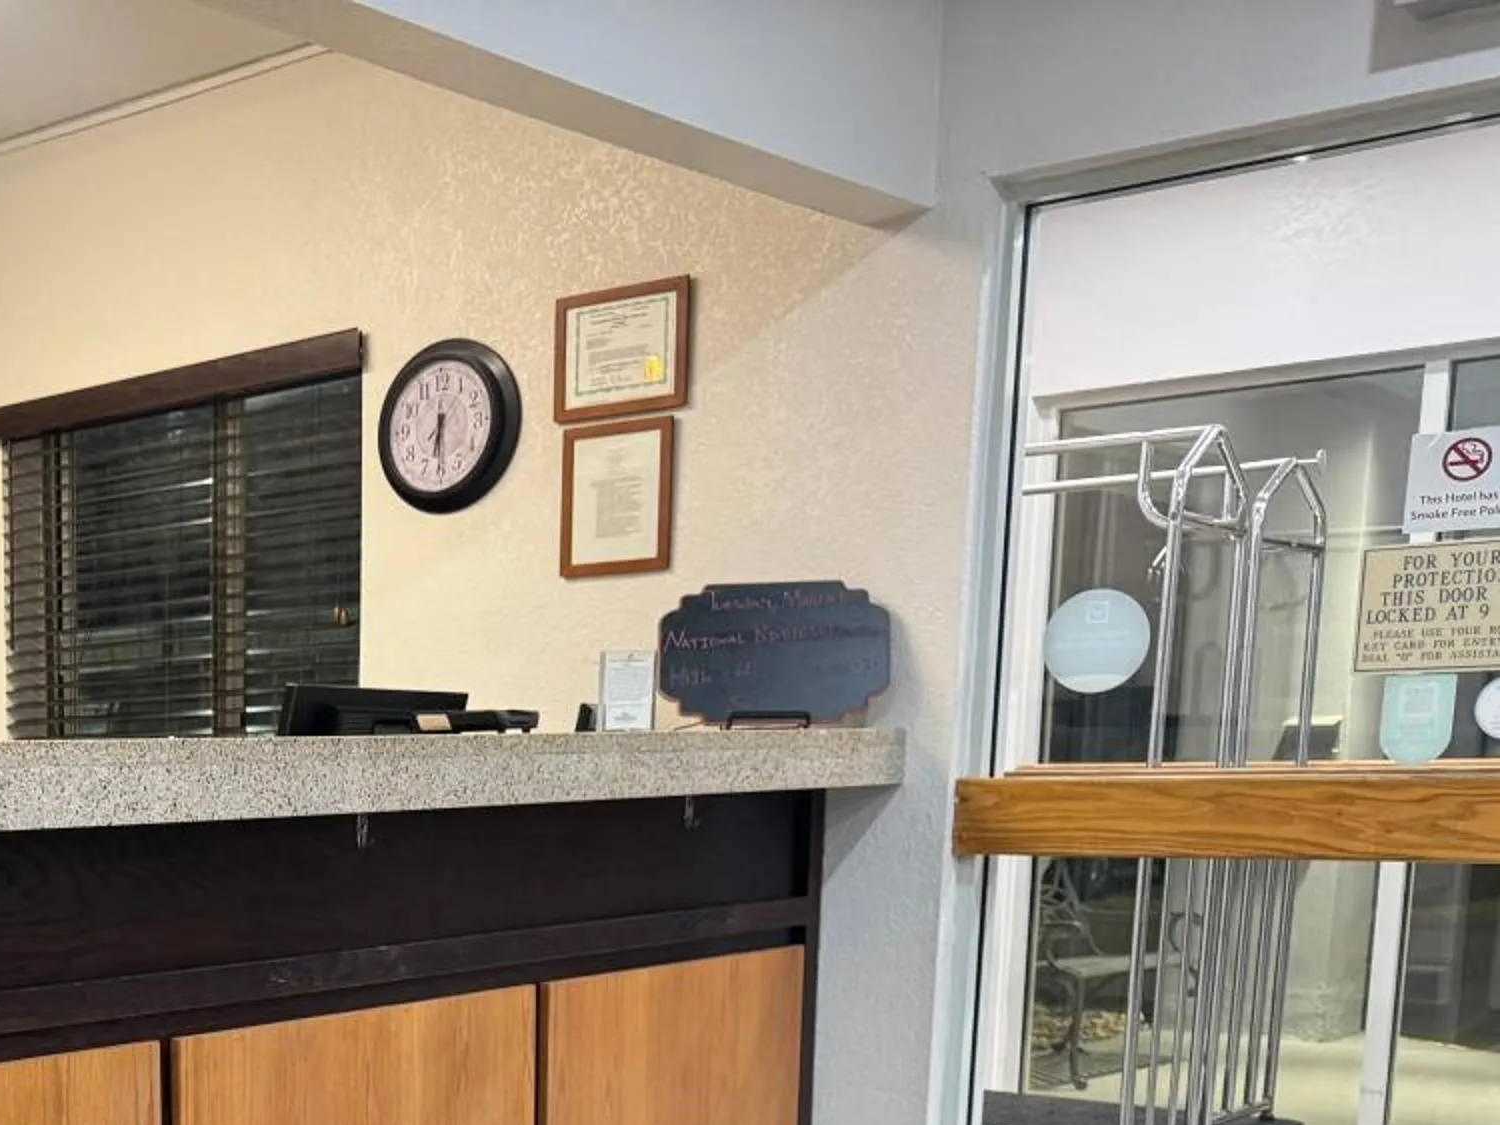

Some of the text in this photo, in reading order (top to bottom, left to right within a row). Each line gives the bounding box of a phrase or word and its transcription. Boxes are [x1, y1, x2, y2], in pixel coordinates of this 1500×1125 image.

[1419, 495, 1443, 505] This
[1445, 492, 1477, 504] Hotel
[1451, 507, 1477, 518] Free
[1403, 549, 1500, 571] FOR YOUR
[1392, 568, 1500, 589] PROTECTIO
[1380, 585, 1487, 607] THIS DOOR
[1366, 603, 1490, 625] LOCKED AT 9
